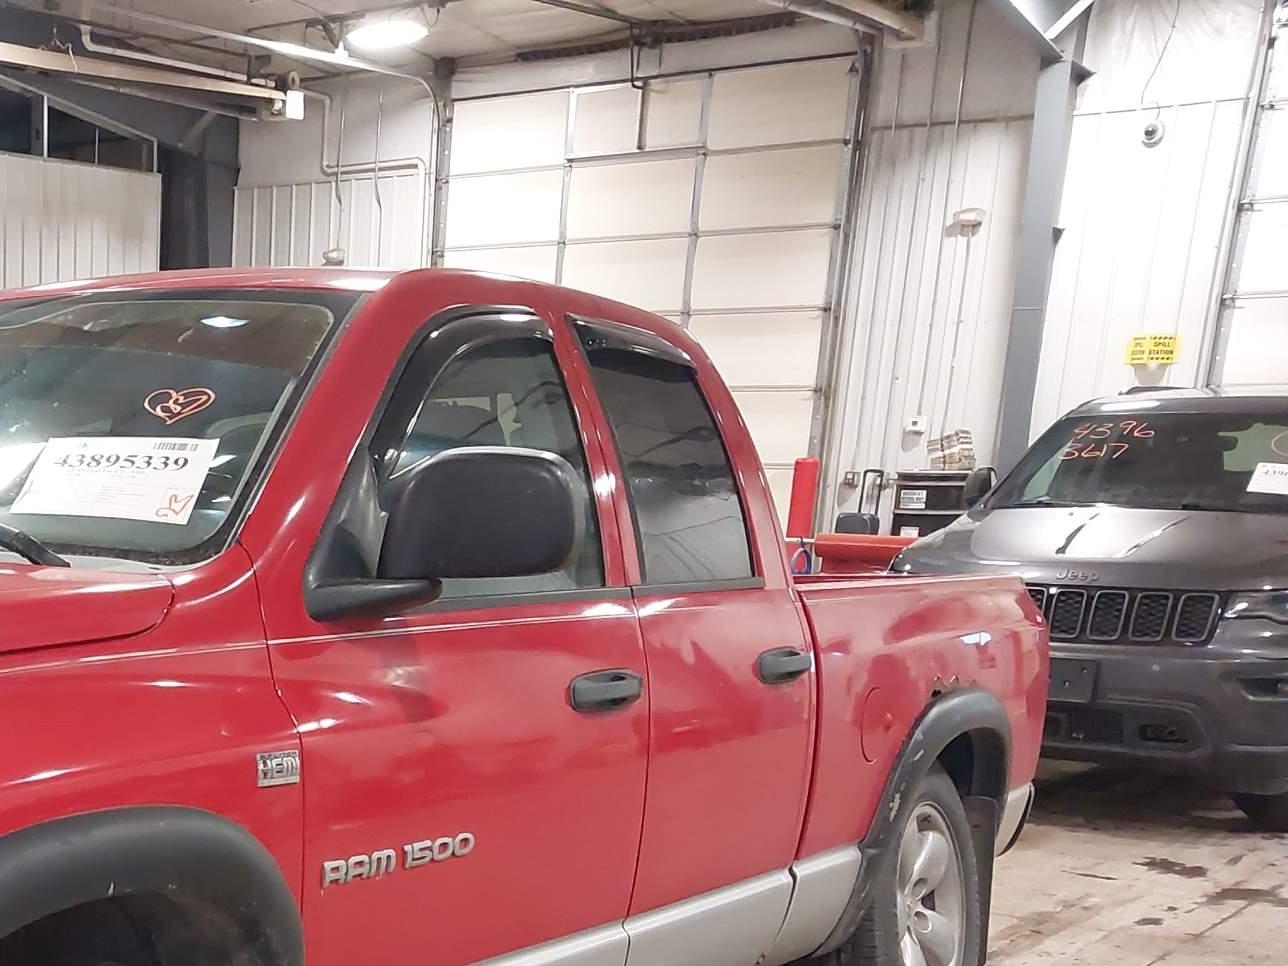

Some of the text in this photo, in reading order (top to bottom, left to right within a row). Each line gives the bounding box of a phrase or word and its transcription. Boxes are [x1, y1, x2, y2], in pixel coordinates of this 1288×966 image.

[53, 453, 190, 471] 43895339
[1056, 568, 1100, 583] Jeep
[322, 832, 476, 888] RAM 1500
